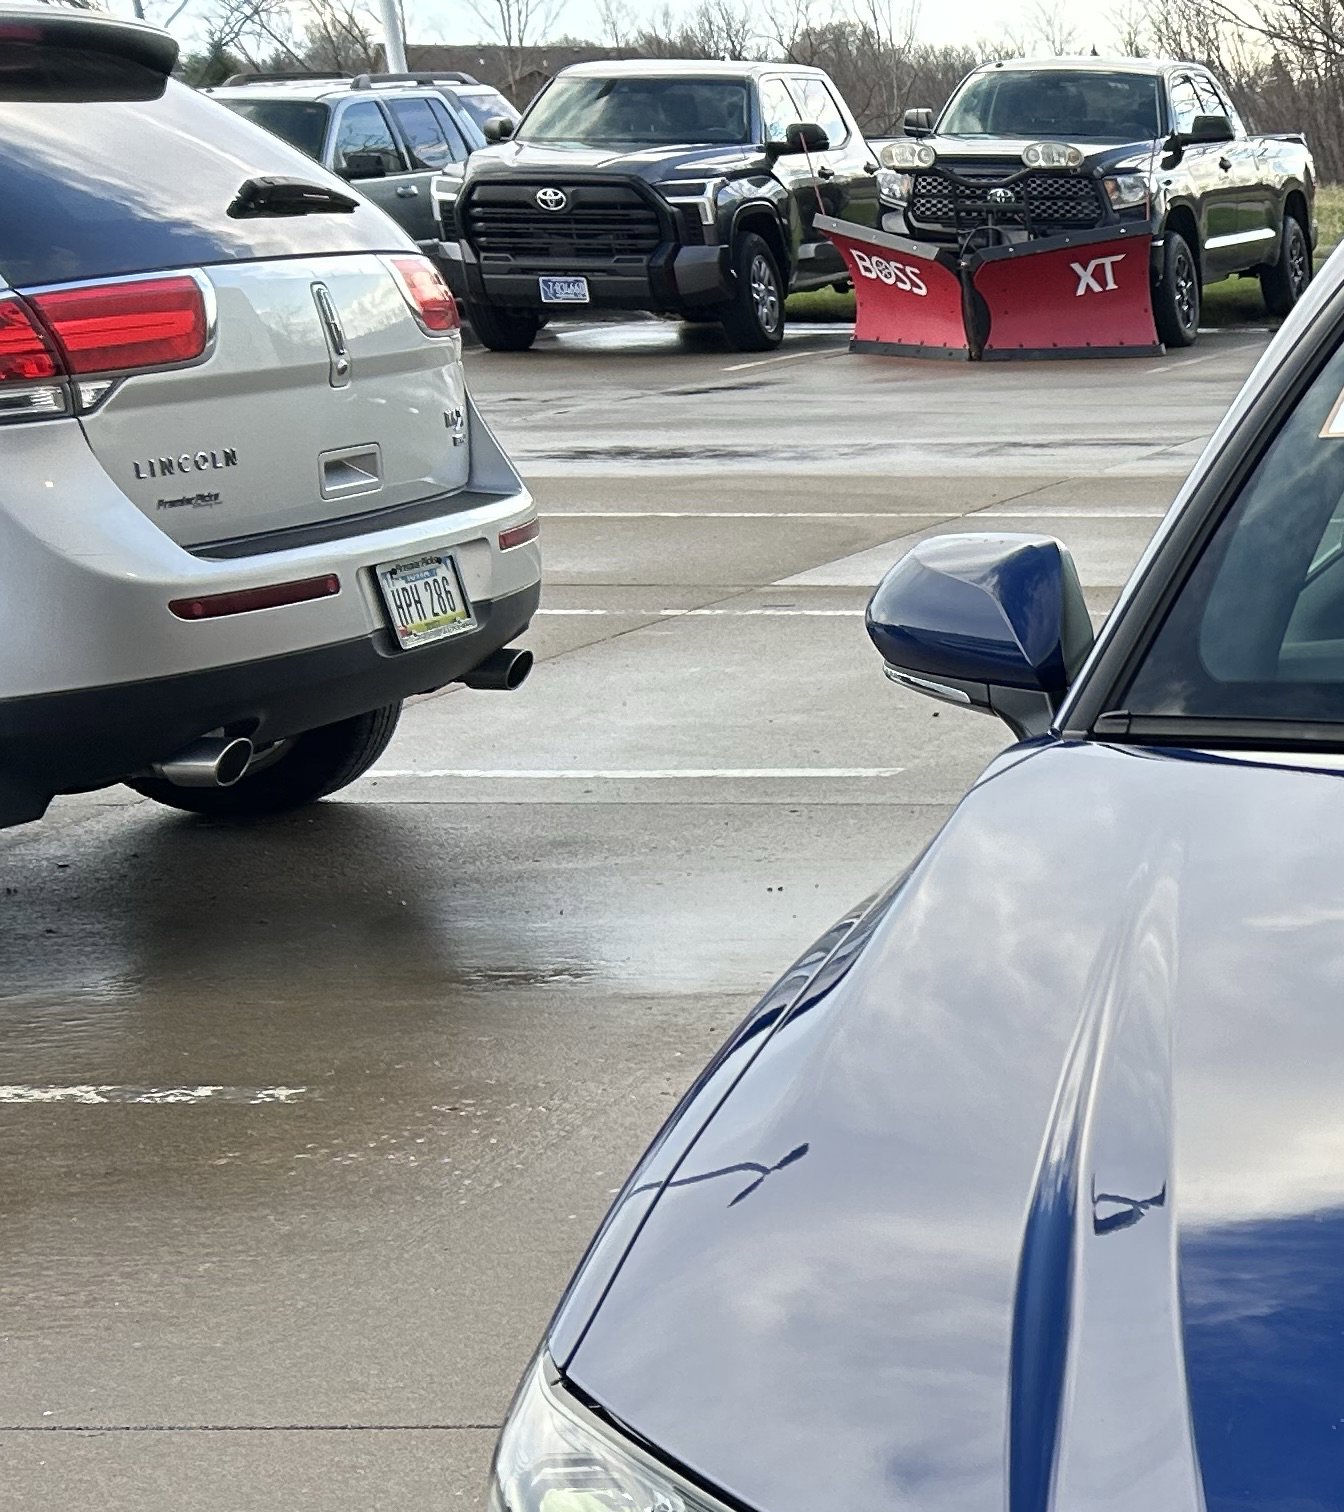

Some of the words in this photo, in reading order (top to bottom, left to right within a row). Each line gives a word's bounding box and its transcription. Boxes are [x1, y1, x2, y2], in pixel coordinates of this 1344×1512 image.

[850, 249, 928, 297] BOSS
[1070, 253, 1127, 297] XT
[132, 447, 239, 480] LINCOLN
[424, 576, 457, 617] 286
